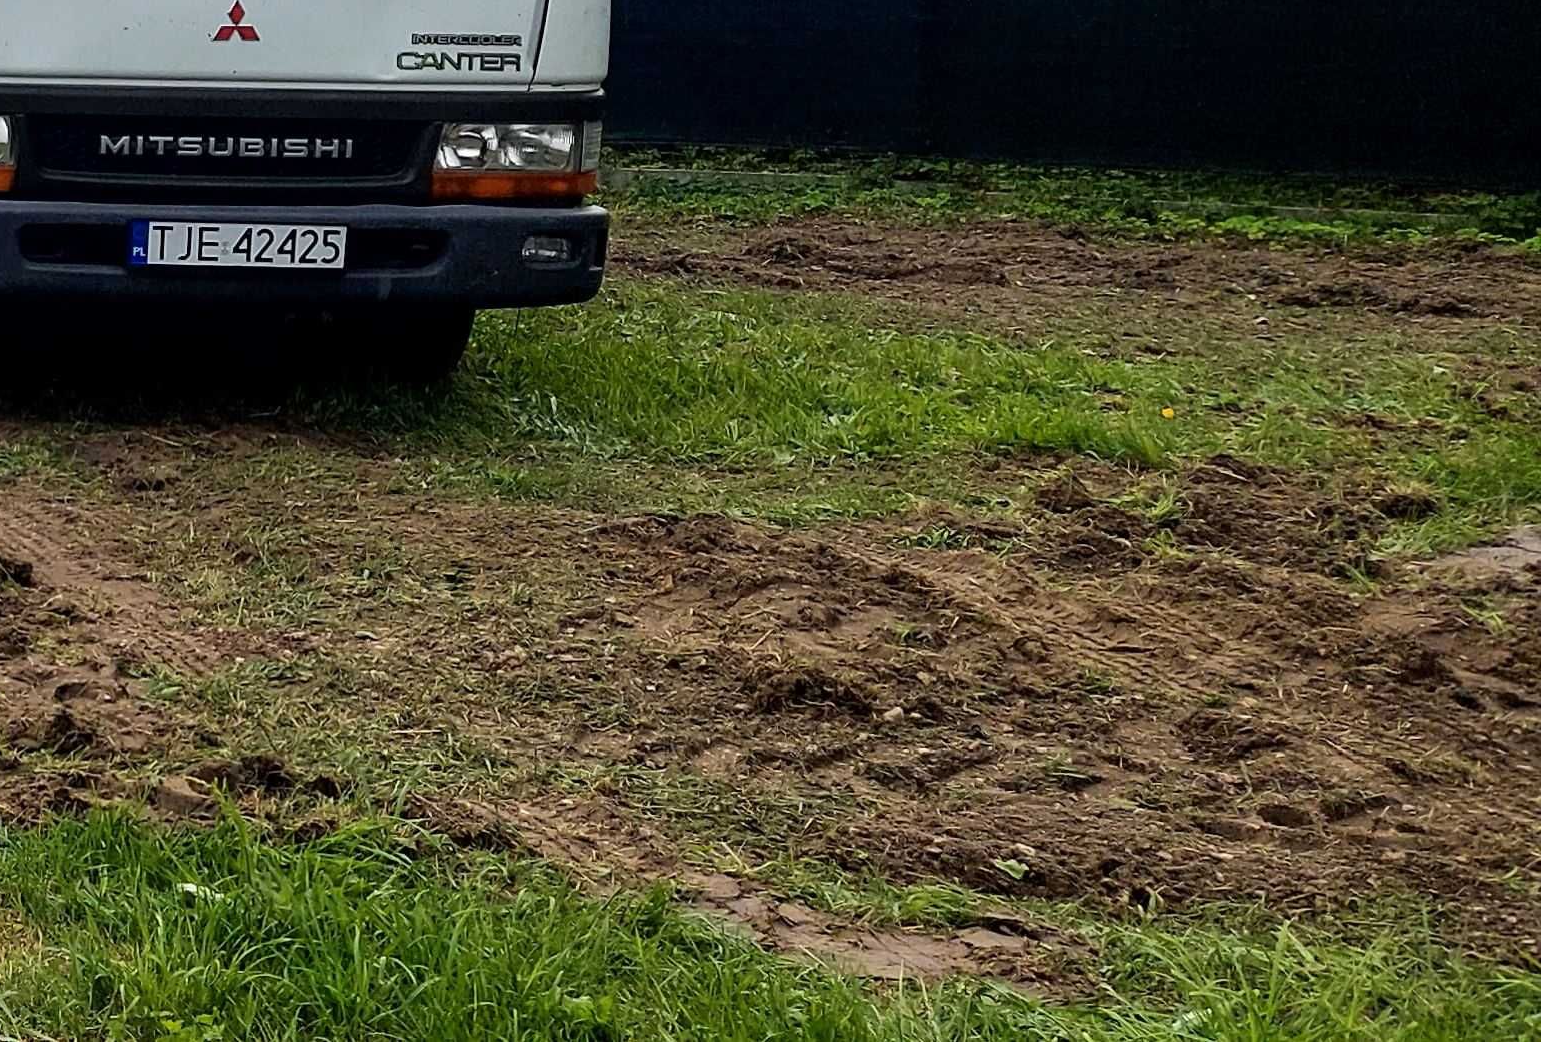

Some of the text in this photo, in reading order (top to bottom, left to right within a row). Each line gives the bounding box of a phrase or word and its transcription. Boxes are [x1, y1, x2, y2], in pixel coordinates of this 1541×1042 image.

[412, 34, 522, 47] INTERCOOLER
[397, 52, 521, 72] CANTER
[99, 135, 353, 158] MITSUBISHI
[132, 246, 146, 257] PL
[152, 225, 342, 264] TJE 42425
